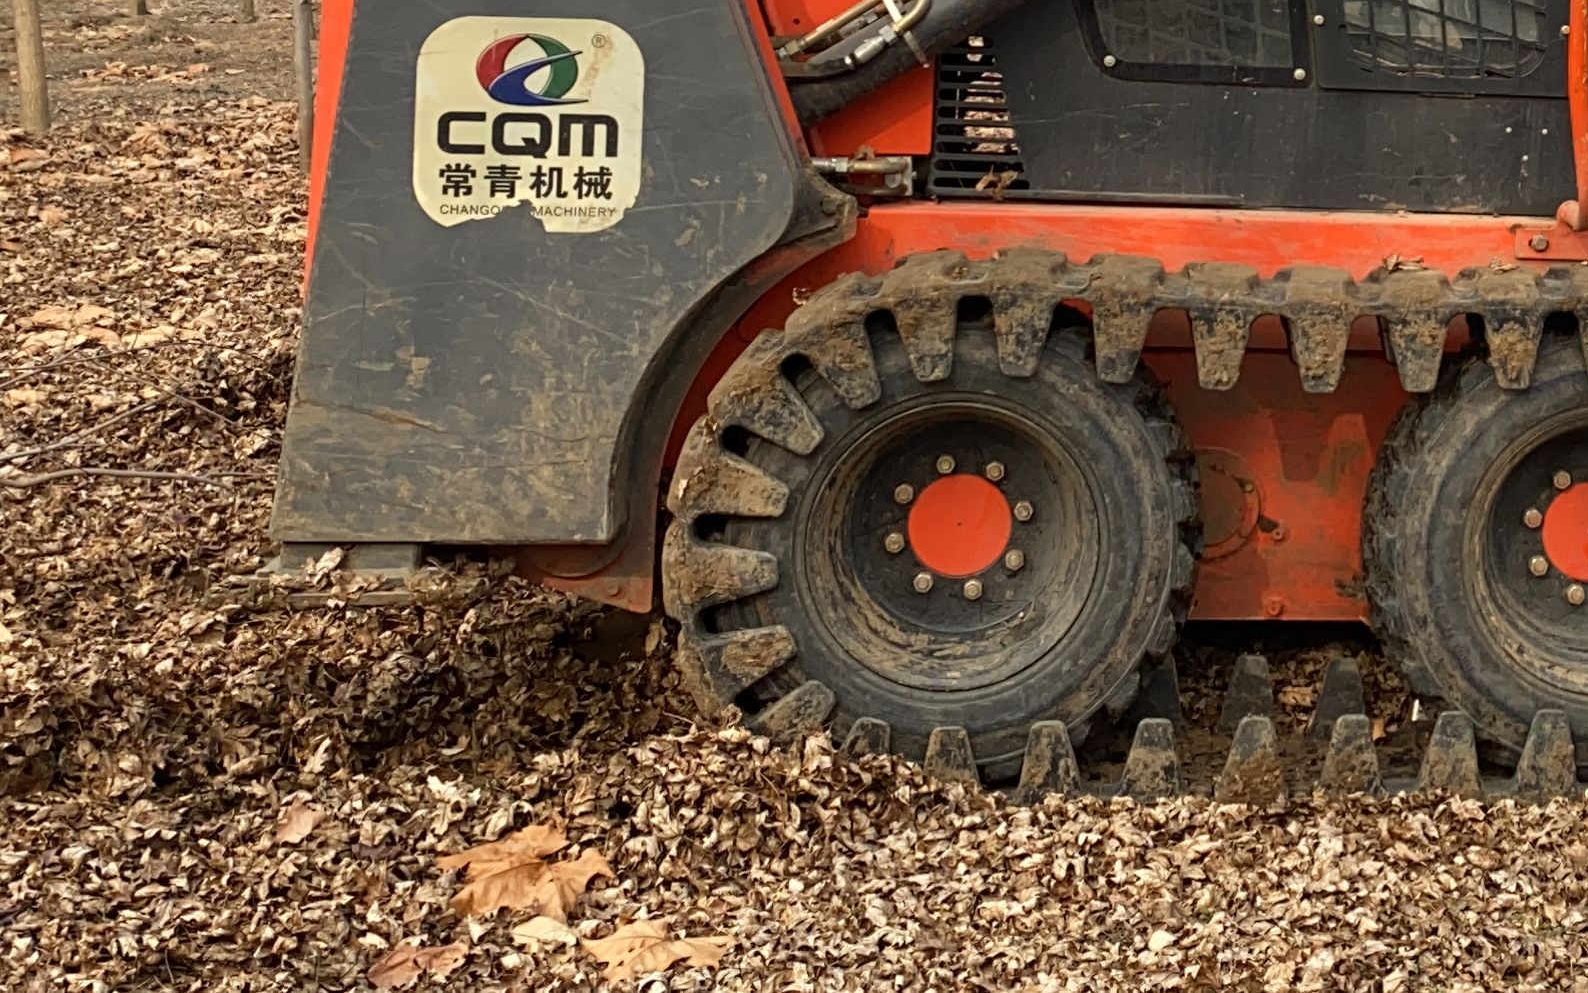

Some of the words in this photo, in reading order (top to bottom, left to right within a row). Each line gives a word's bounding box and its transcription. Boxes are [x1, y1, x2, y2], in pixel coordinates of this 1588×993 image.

[437, 111, 619, 159] CQM
[438, 162, 613, 200] 常青机械
[532, 206, 615, 217] MACHINERY
